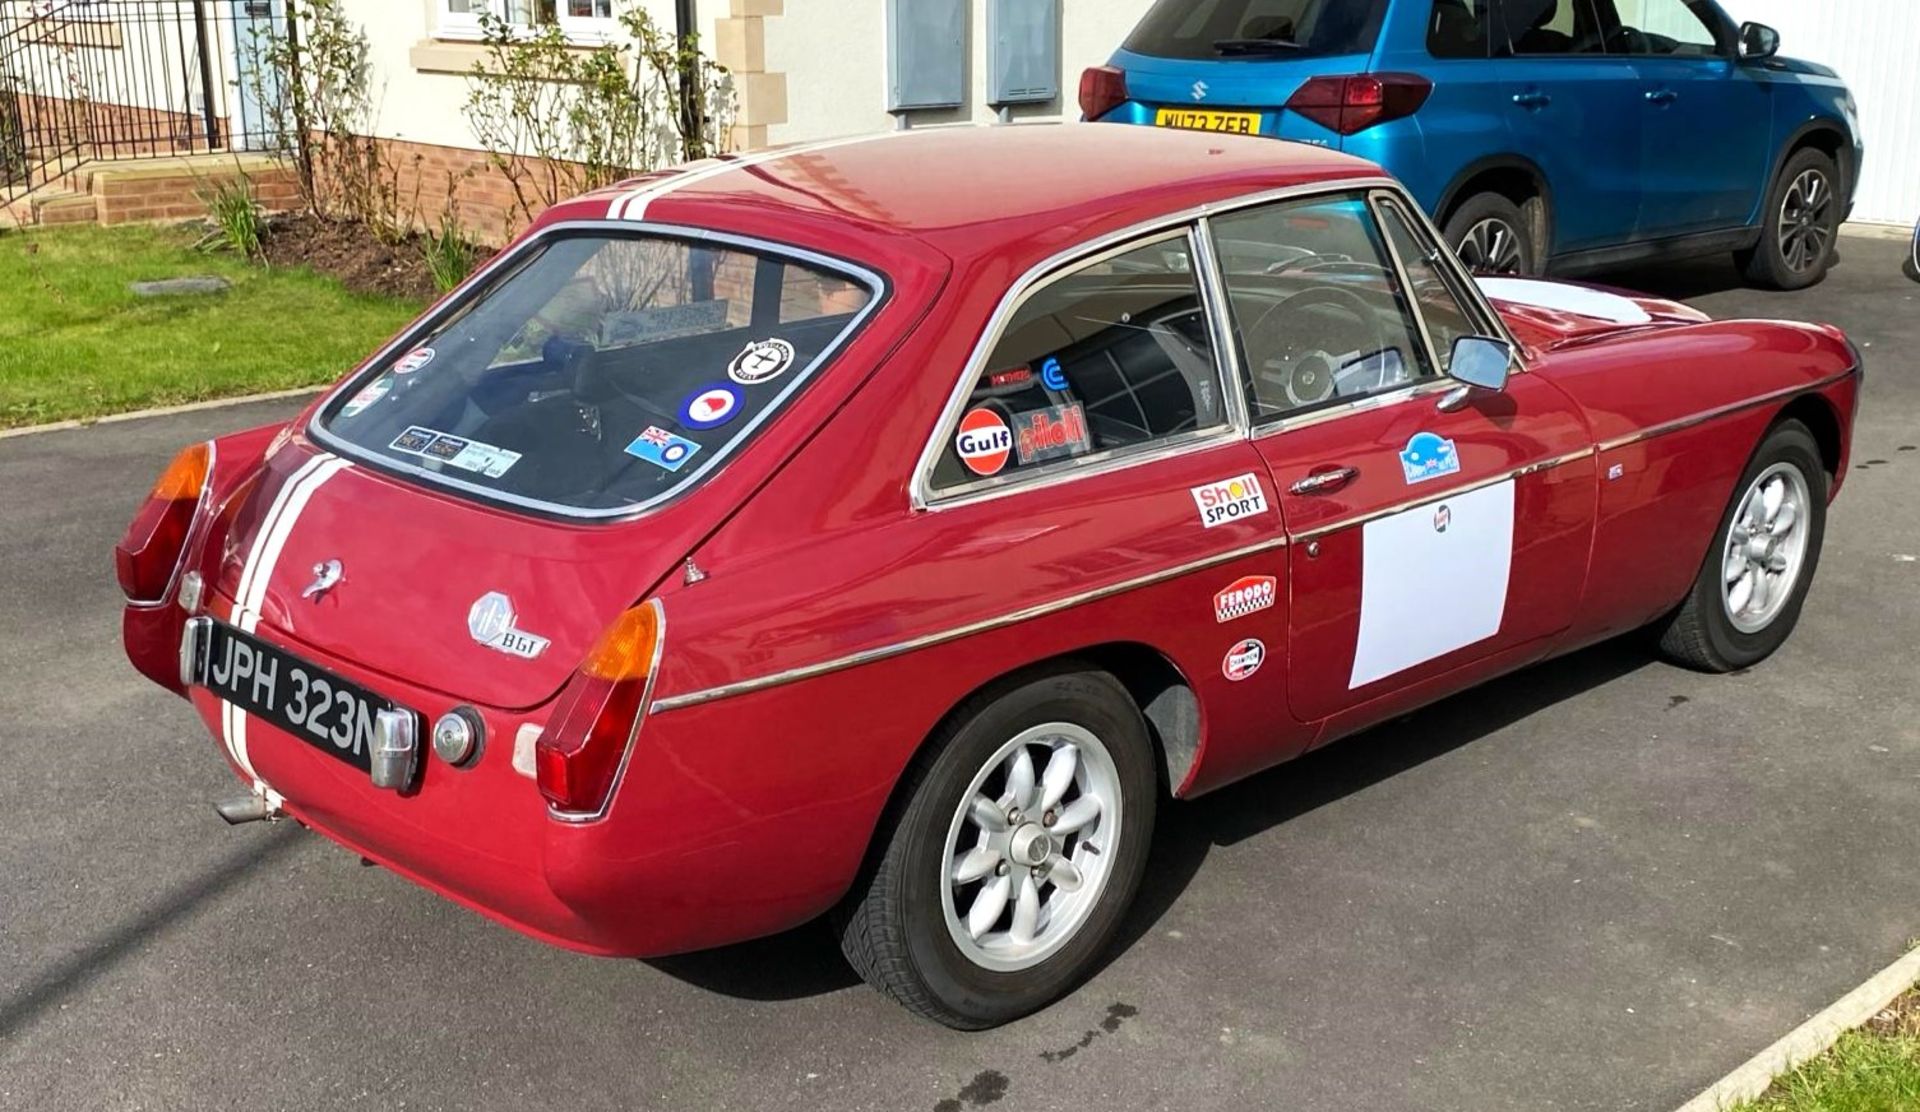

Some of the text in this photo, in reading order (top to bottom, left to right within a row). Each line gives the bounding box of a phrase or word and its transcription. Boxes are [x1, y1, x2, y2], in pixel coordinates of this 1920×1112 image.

[959, 430, 1009, 455] Gulf
[1206, 495, 1260, 524] SPORT
[1220, 580, 1272, 610] FERODO
[212, 636, 377, 756] JPH 323N
